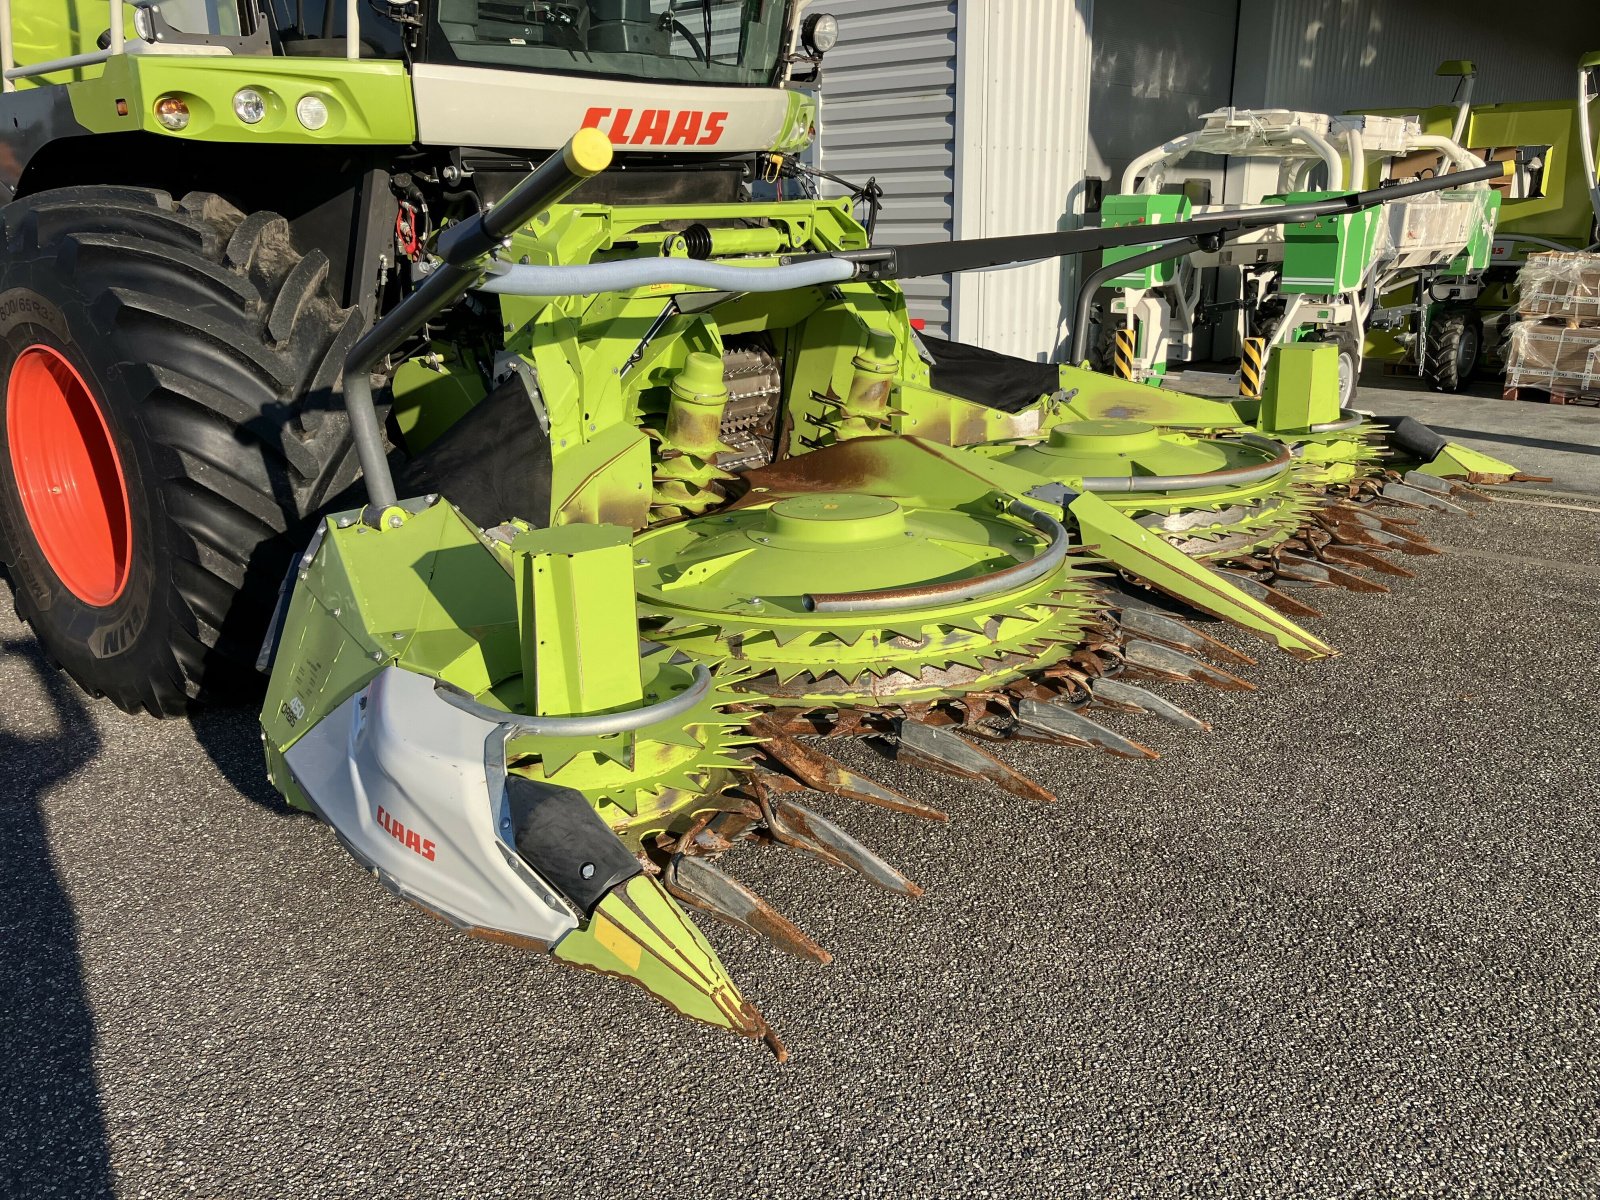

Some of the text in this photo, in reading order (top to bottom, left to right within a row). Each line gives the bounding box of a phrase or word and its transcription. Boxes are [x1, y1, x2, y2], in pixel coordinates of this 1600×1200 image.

[281, 702, 298, 728] ORBIS
[290, 697, 305, 720] 450
[376, 804, 436, 862] CLAAS
